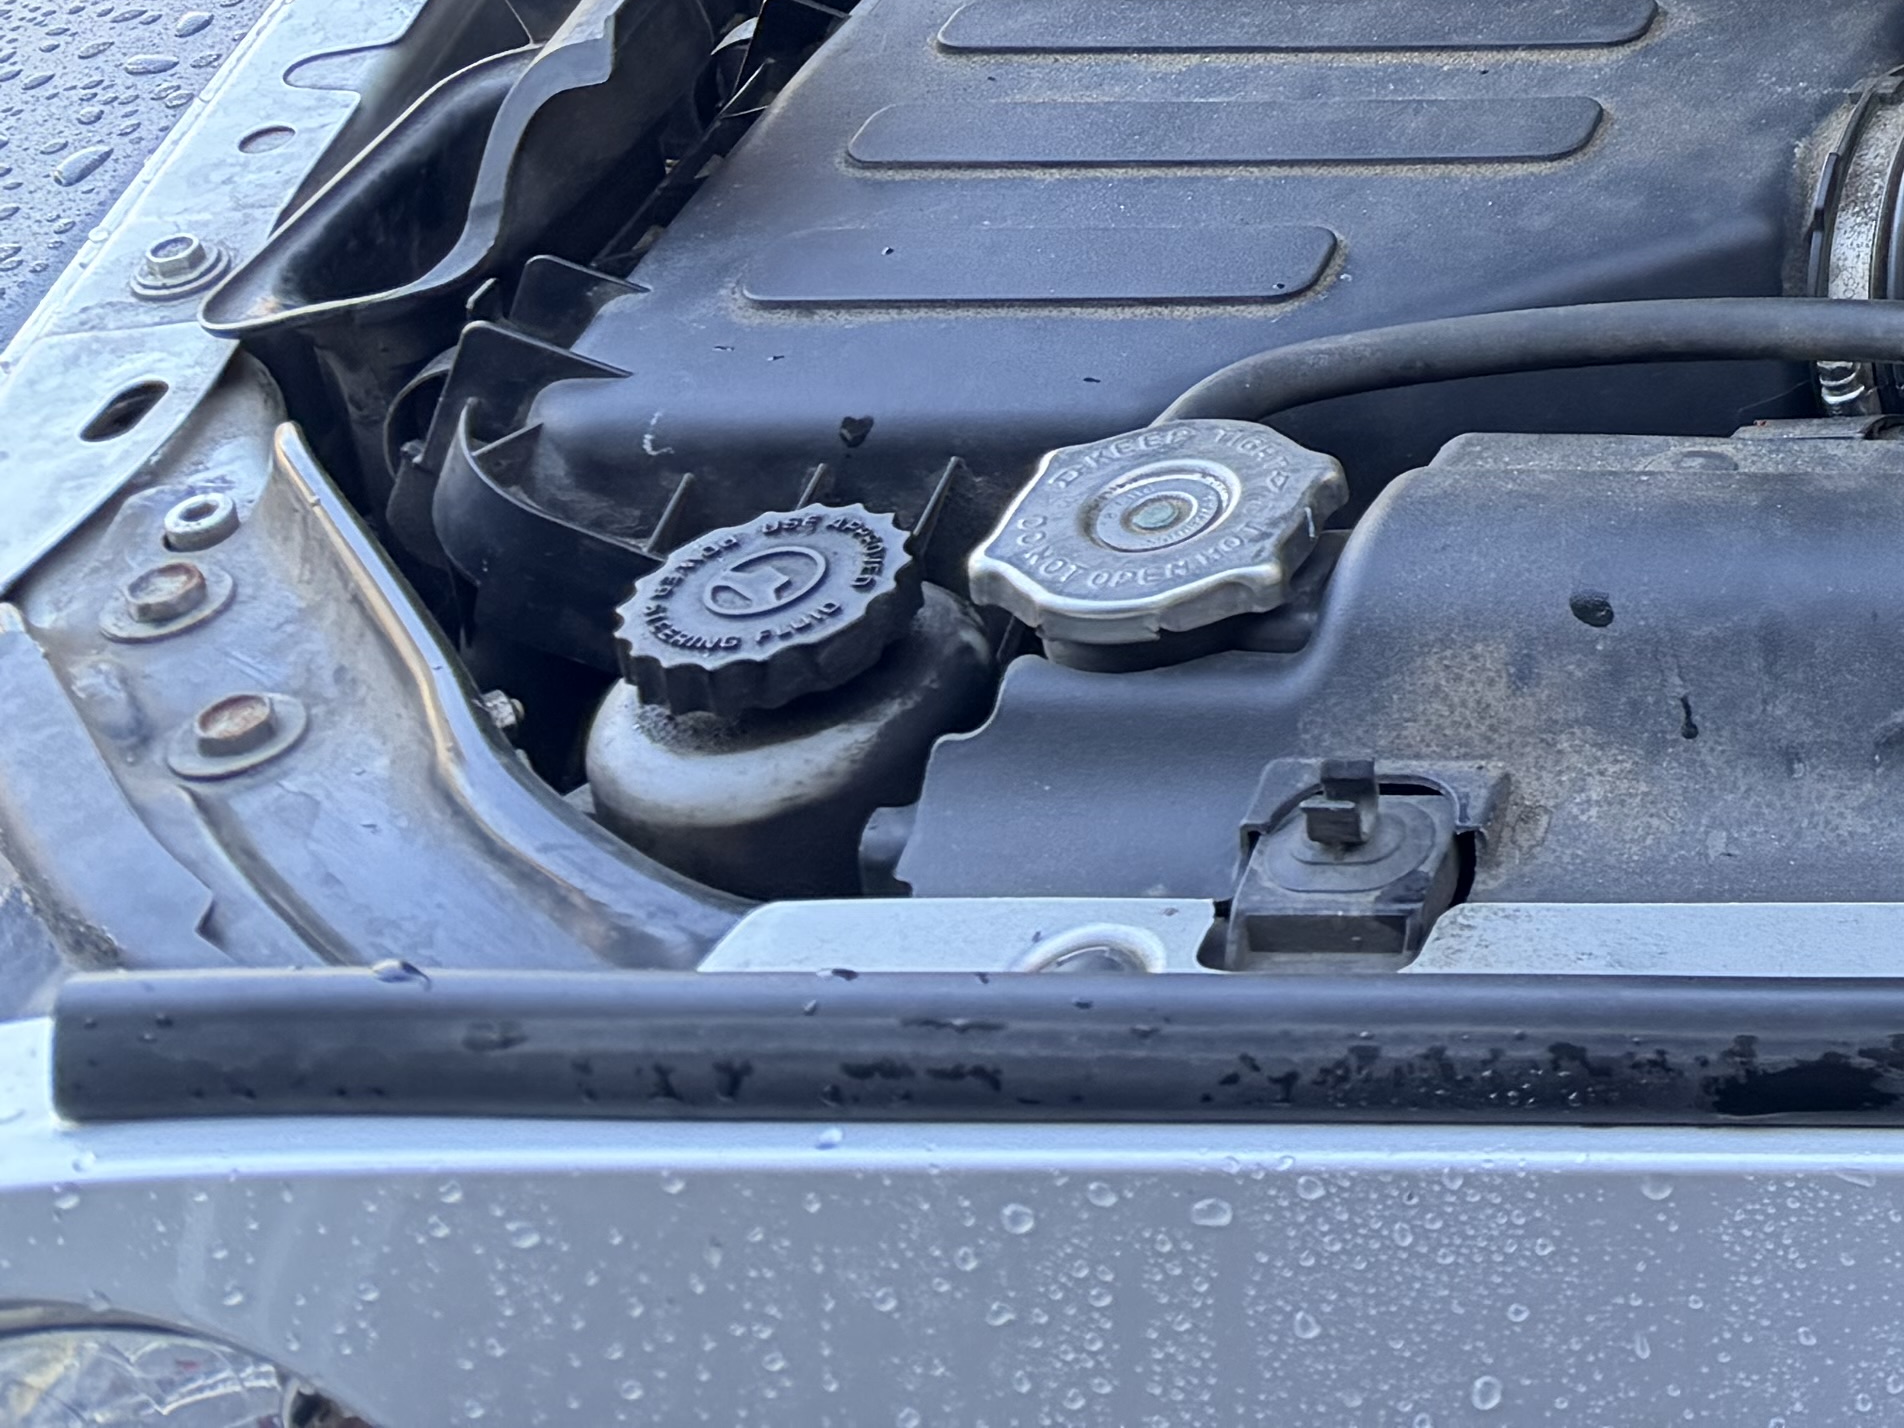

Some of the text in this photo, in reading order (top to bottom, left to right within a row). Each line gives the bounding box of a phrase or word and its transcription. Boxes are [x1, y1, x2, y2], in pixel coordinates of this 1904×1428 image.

[1084, 428, 1196, 470] KEEP
[760, 515, 822, 537] USE
[1022, 544, 1088, 582] NOT
[1086, 559, 1191, 590] OPEN
[754, 600, 842, 646] FLUID
